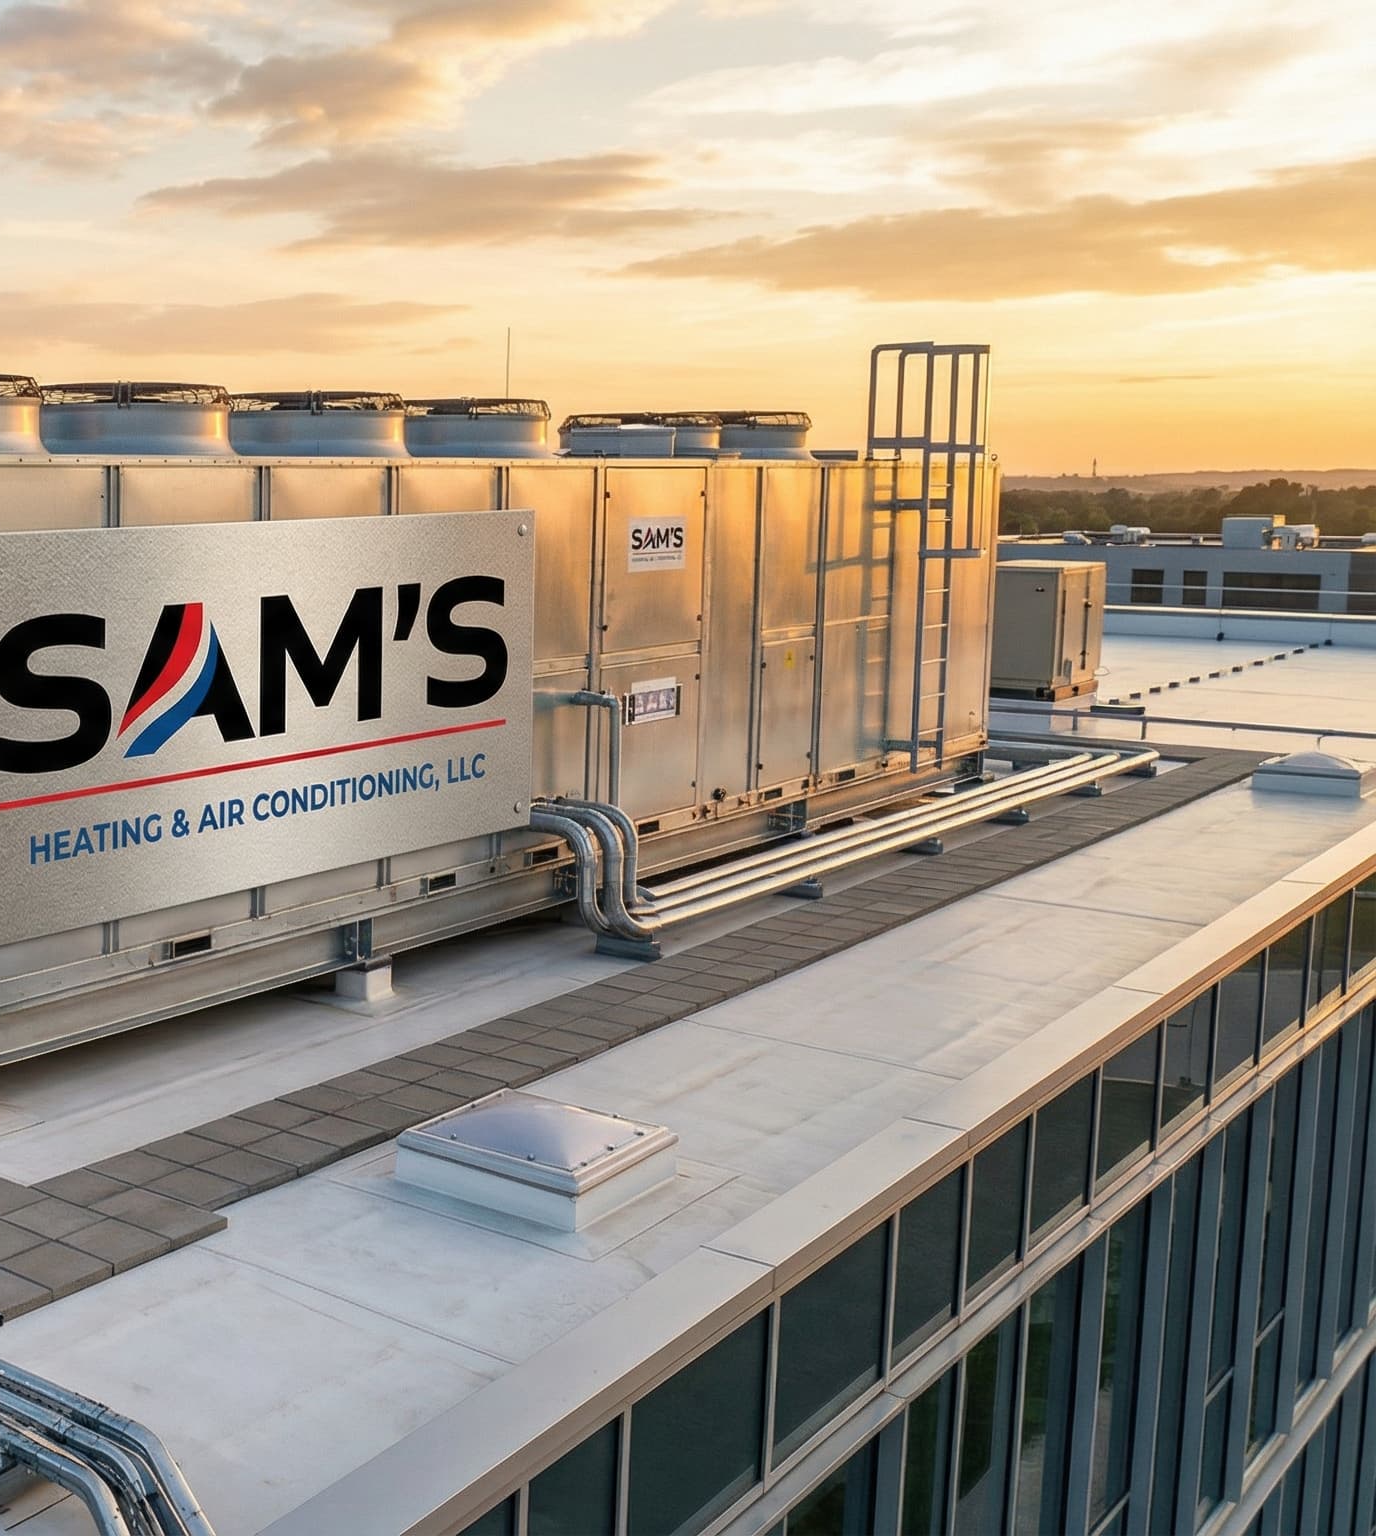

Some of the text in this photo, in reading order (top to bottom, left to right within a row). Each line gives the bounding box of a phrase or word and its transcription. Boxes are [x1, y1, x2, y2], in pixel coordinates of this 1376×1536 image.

[631, 527, 684, 550] SAM'S
[29, 752, 486, 865] HEATING & AIR CONDITIONING, LLC
